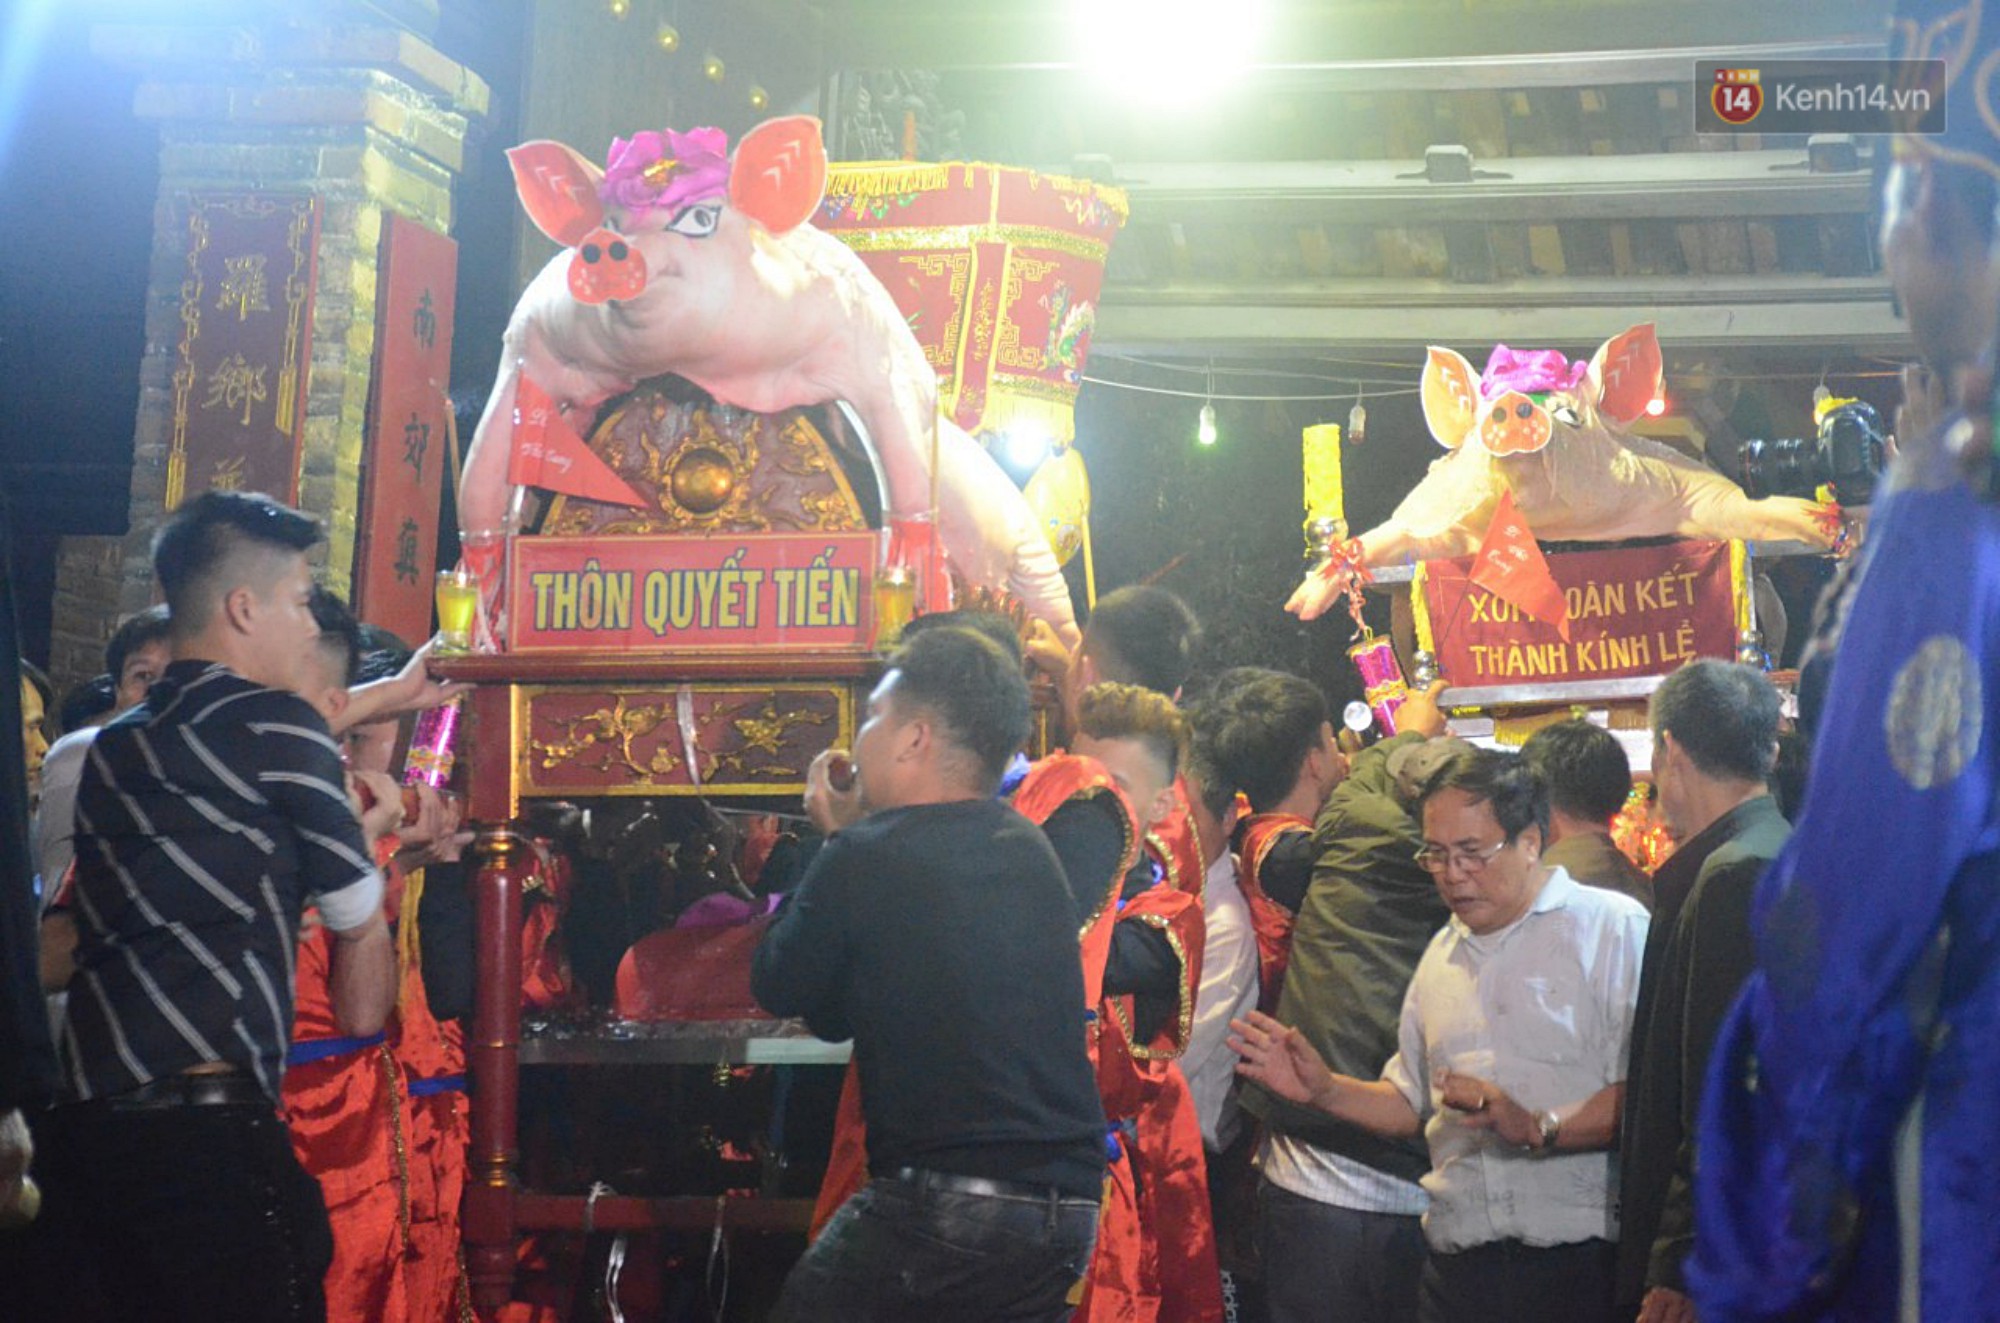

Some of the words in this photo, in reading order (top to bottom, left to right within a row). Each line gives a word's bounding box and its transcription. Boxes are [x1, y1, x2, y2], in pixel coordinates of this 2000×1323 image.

[532, 557, 633, 631] THÔN
[643, 547, 764, 637] QUYẾT
[773, 547, 859, 627] TIẾN
[1564, 579, 1626, 620] OÀN
[1635, 562, 1699, 613] KẾT
[1469, 638, 1569, 677] THÀNH
[1576, 630, 1651, 673] KÍNH
